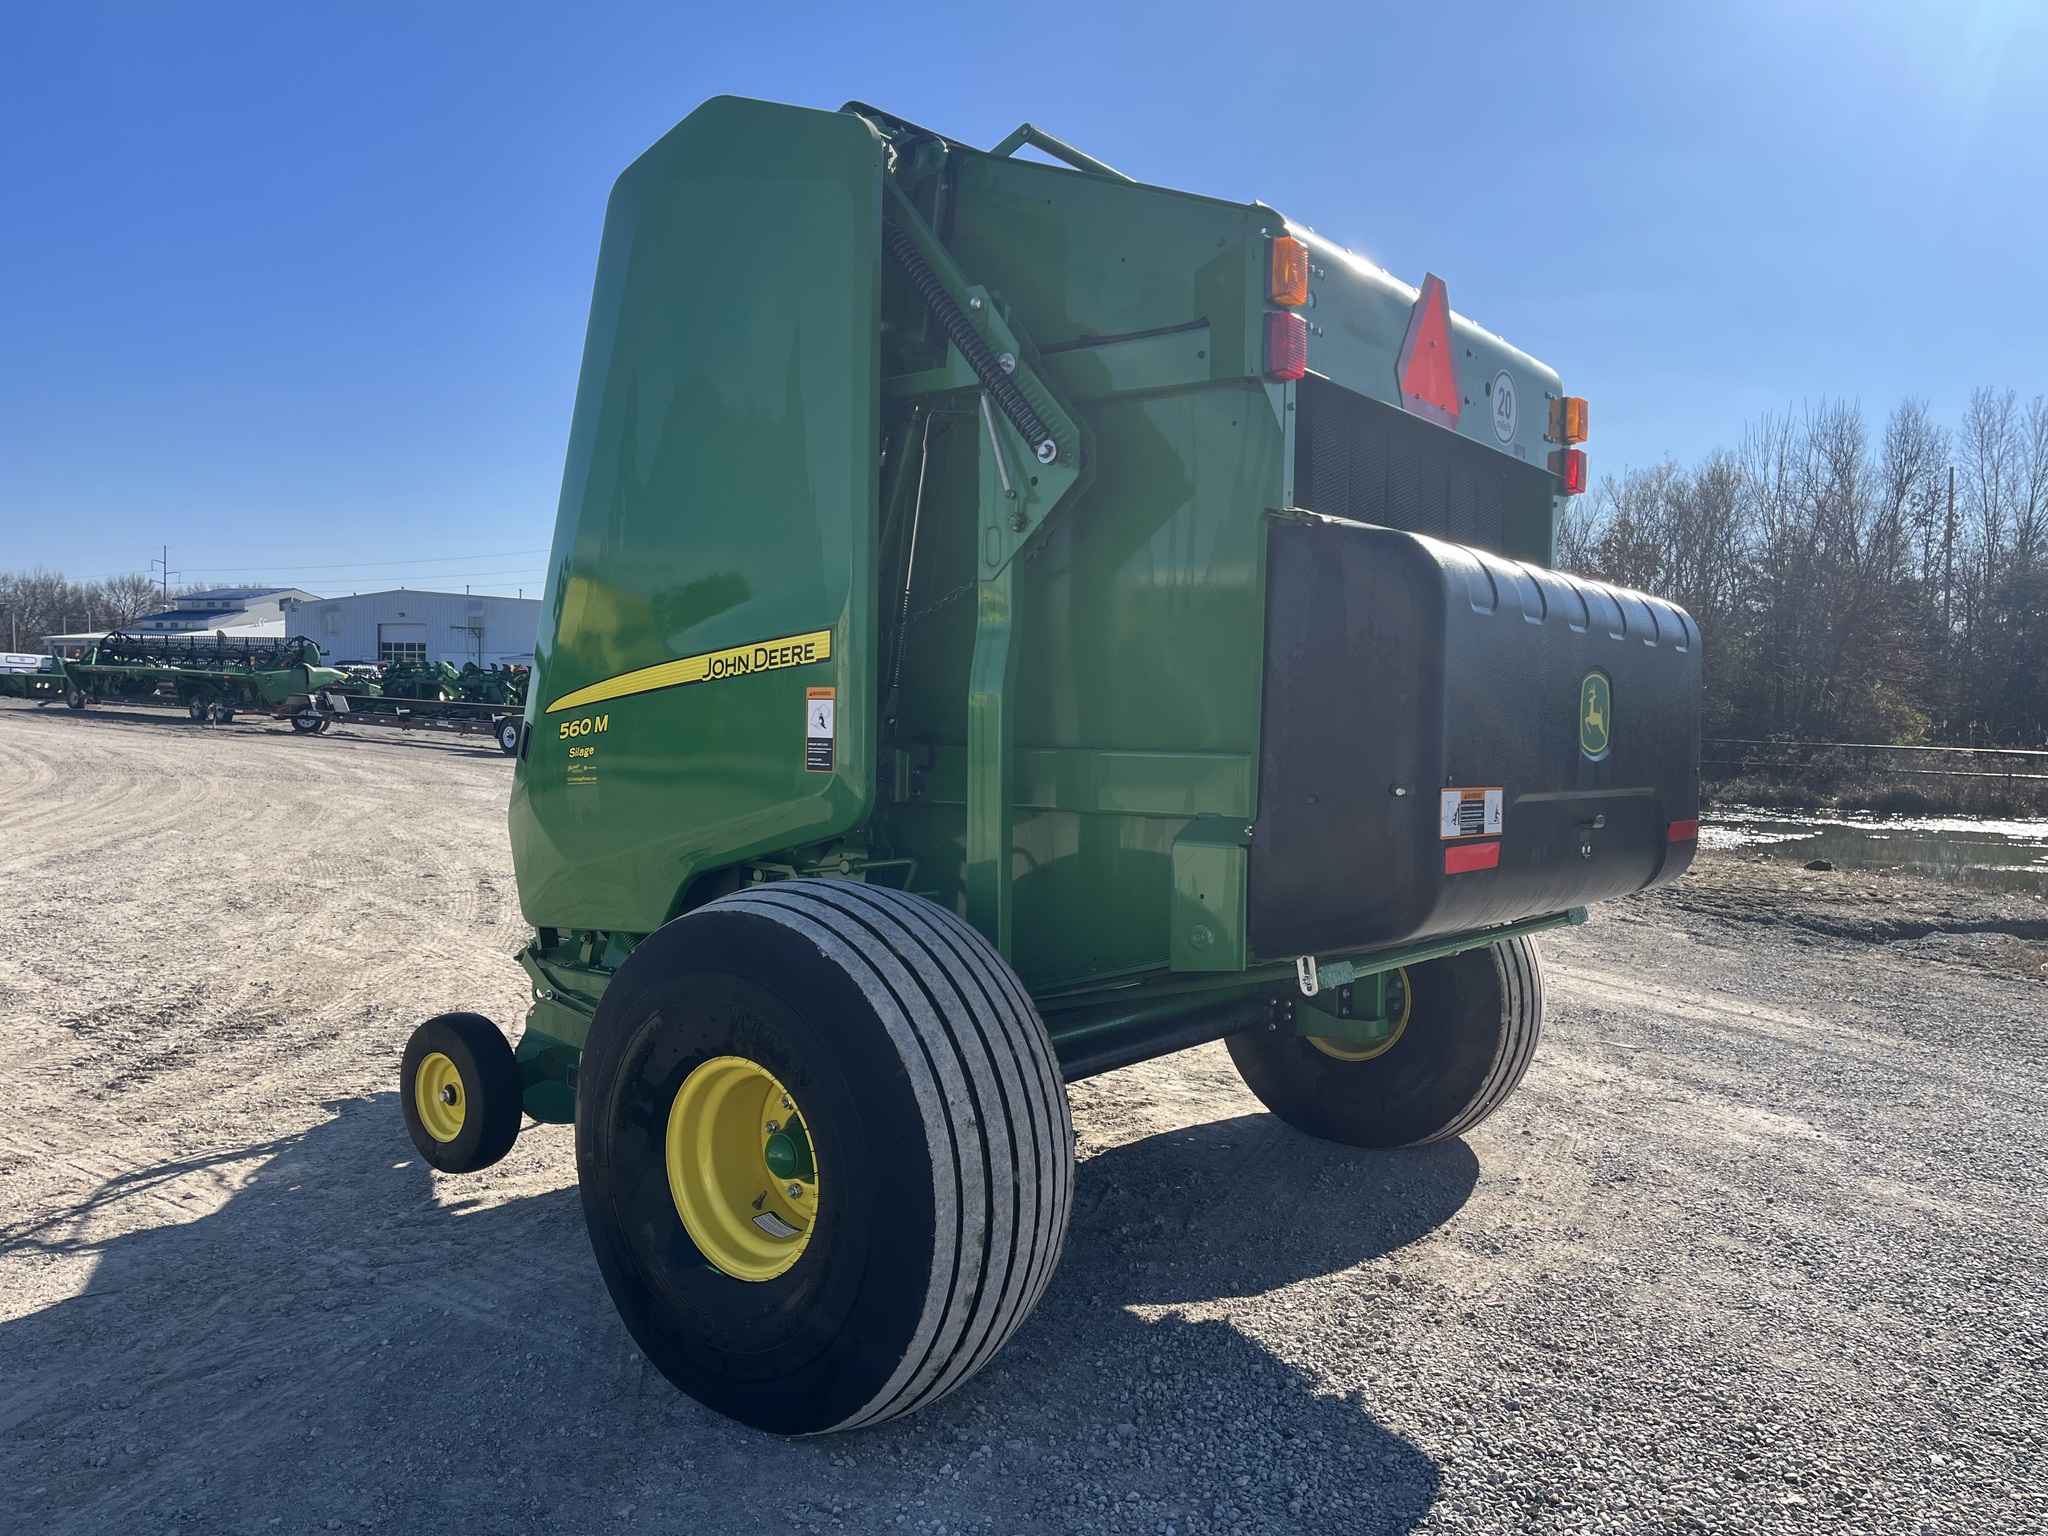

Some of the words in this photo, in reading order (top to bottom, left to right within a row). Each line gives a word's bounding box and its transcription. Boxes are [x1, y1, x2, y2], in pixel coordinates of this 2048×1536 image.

[1497, 386, 1512, 420] 20
[702, 654, 749, 679] JOHN
[754, 642, 815, 670] DEERE
[559, 718, 592, 740] 560
[594, 714, 609, 733] M
[568, 746, 595, 758] Silage
